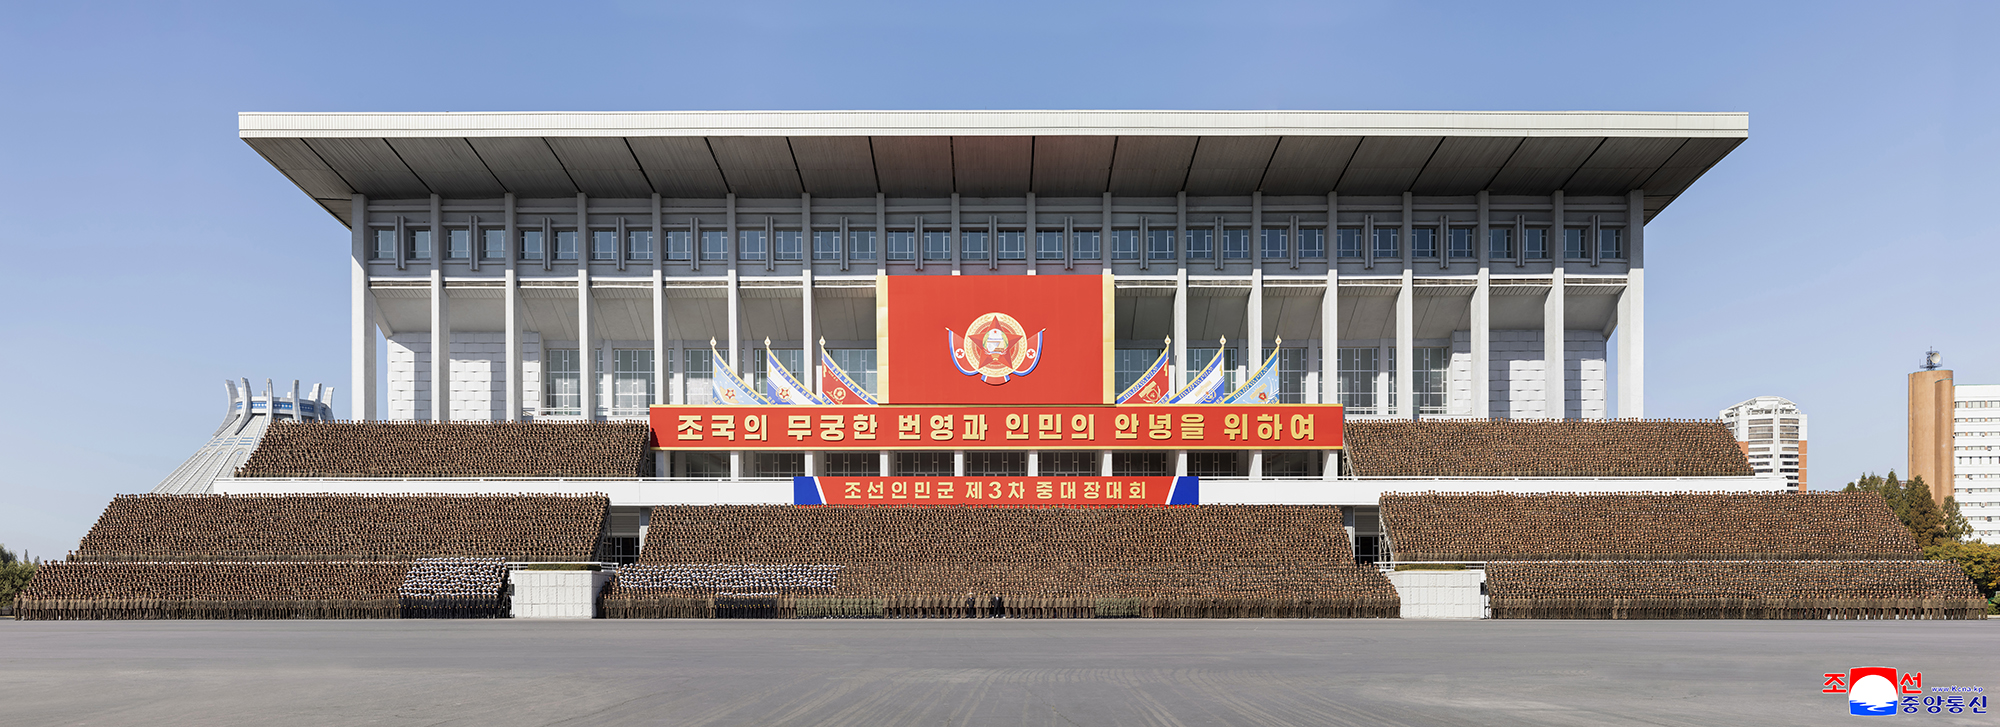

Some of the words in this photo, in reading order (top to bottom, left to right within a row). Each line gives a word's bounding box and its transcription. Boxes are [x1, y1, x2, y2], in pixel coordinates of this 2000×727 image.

[678, 414, 768, 441] 조국의
[788, 414, 878, 441] 무궁한
[898, 414, 988, 441] 번영과
[1005, 413, 1095, 440] 인민의
[1115, 413, 1205, 440] 안녕을
[1224, 413, 1314, 440] 위하여
[844, 481, 955, 500] 조선인민군
[965, 481, 1026, 500] 제3차
[1035, 481, 1146, 500] 중대장대회
